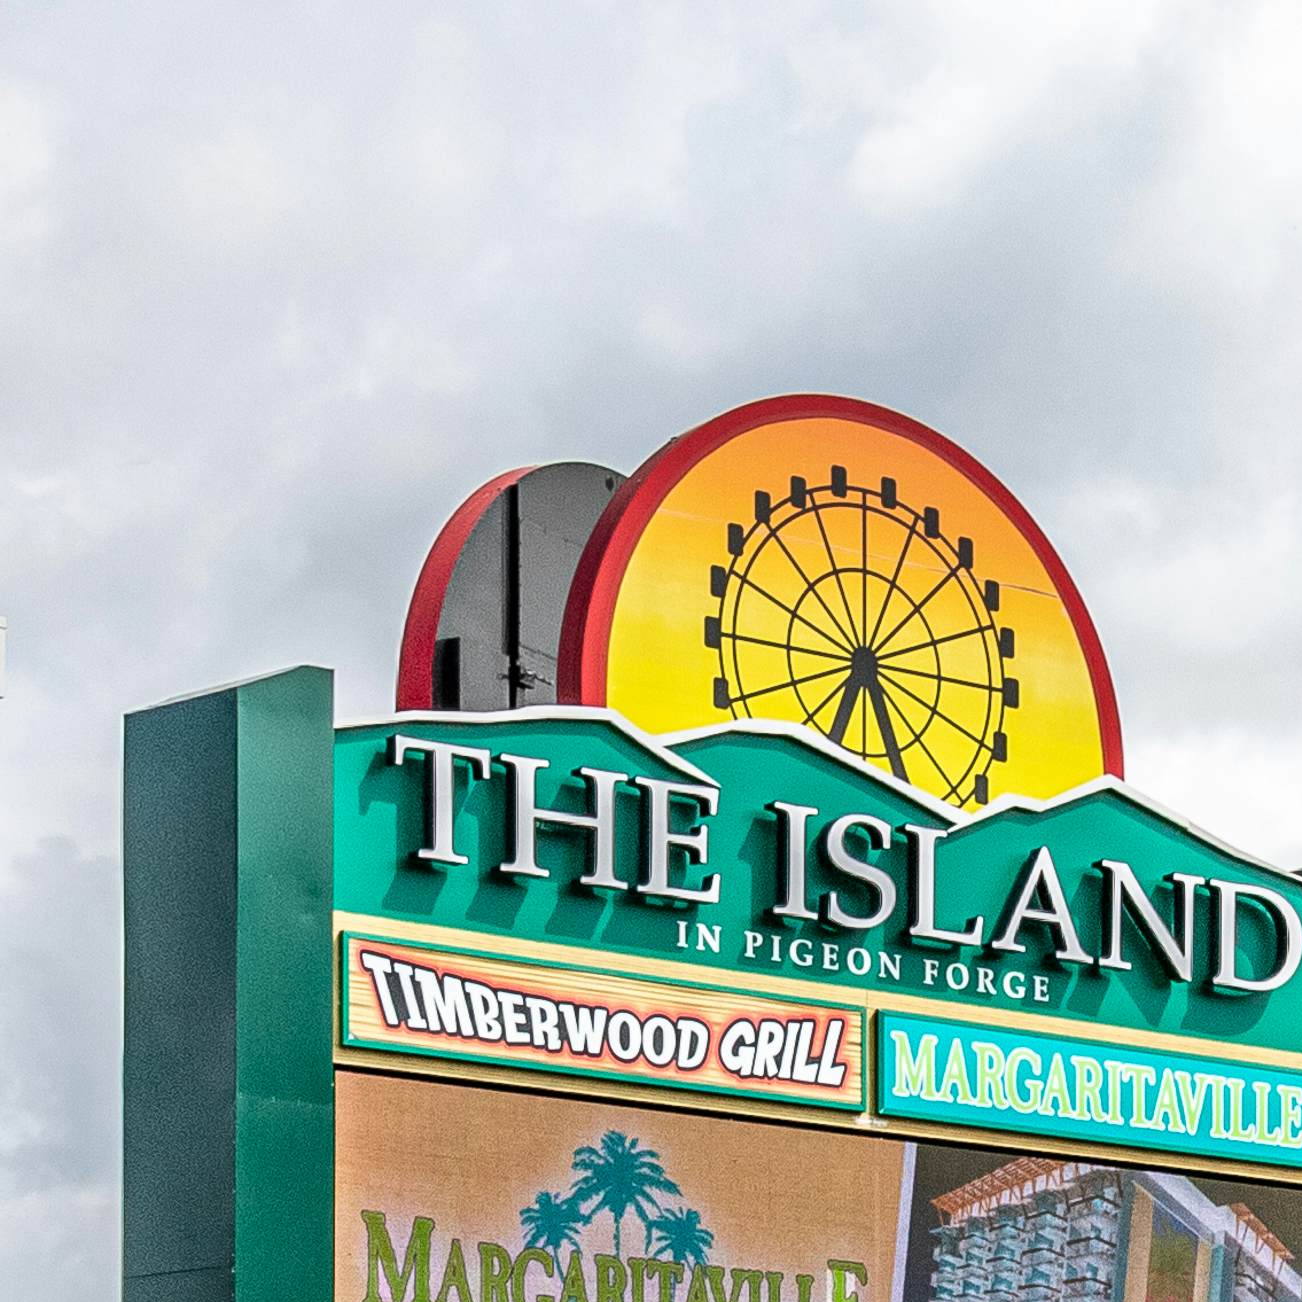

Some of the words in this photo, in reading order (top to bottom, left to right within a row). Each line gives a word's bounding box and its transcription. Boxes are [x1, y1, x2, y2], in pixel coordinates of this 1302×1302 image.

[392, 734, 722, 904] THE
[360, 951, 710, 1070] TIMBERWOOD
[718, 1018, 848, 1088] GRILL
[677, 920, 722, 954] IN
[744, 930, 901, 981] PIGEON
[924, 959, 1050, 1003] FORGE
